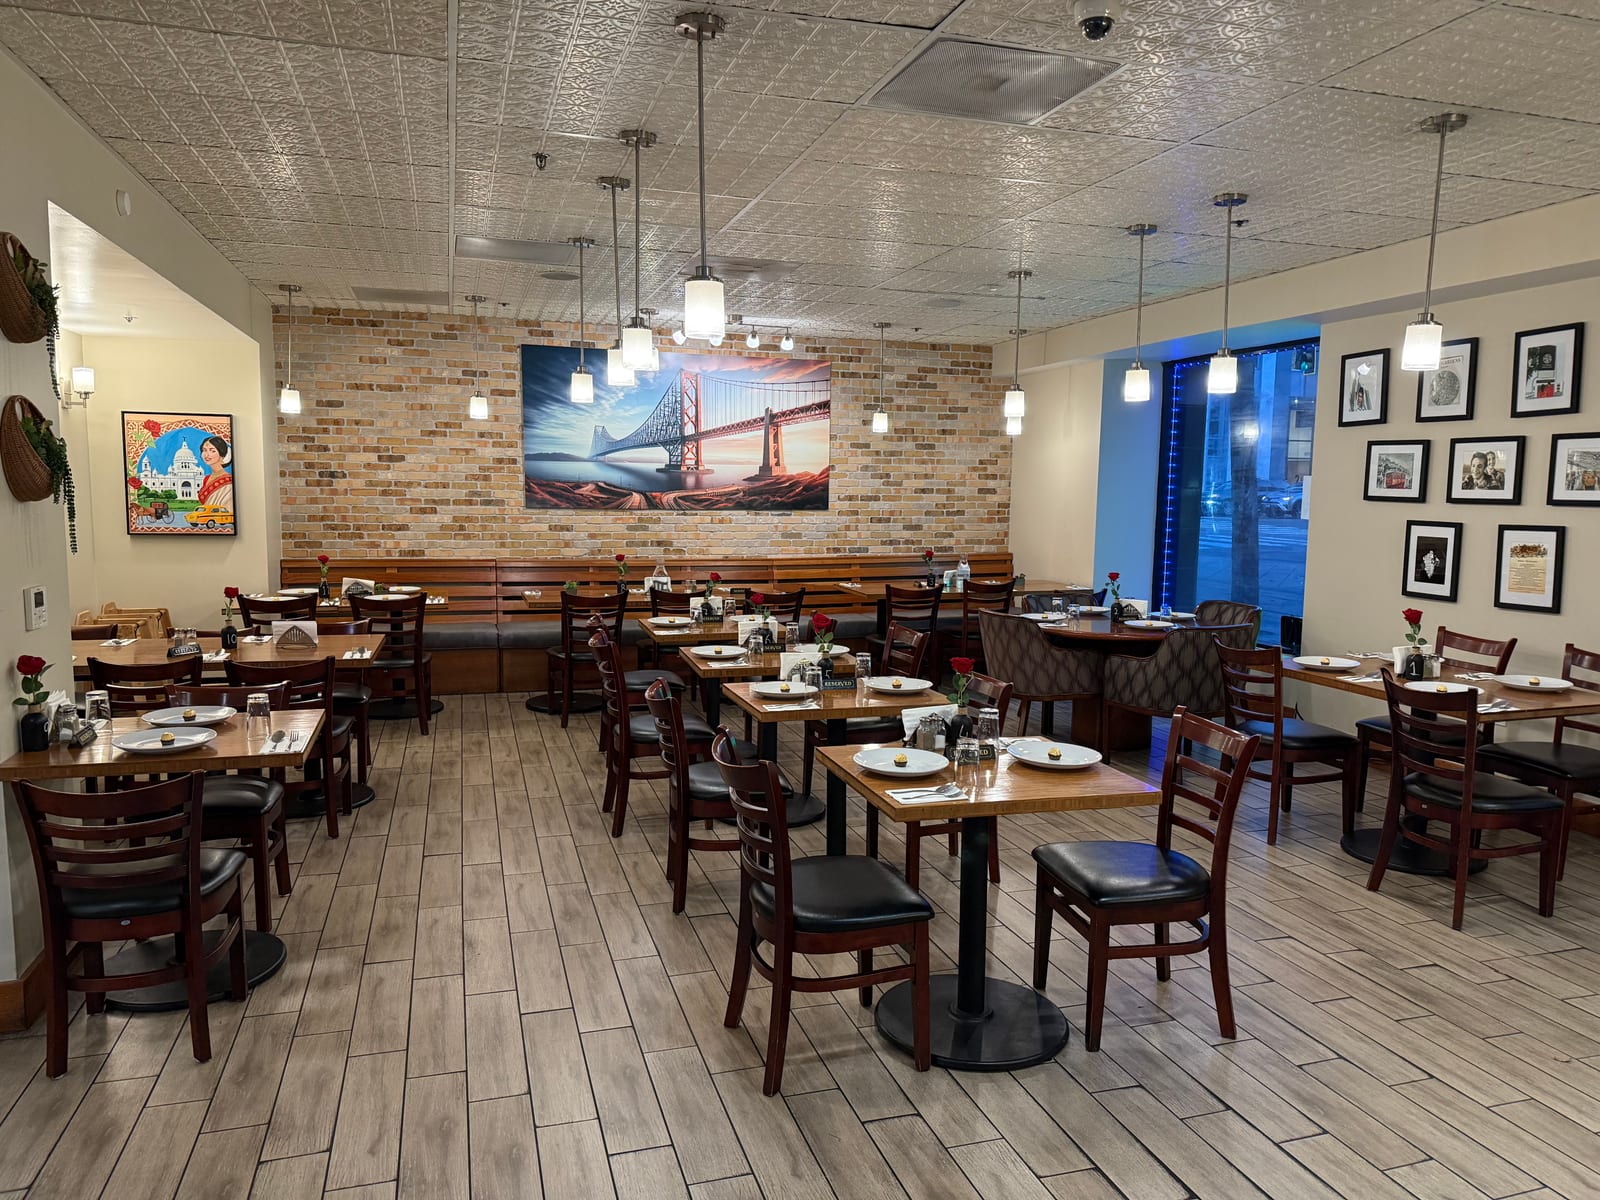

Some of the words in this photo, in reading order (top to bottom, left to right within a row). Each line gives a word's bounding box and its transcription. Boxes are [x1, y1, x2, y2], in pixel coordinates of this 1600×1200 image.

[929, 577, 934, 586] 3
[227, 633, 237, 645] 10
[1409, 661, 1420, 676] 1
